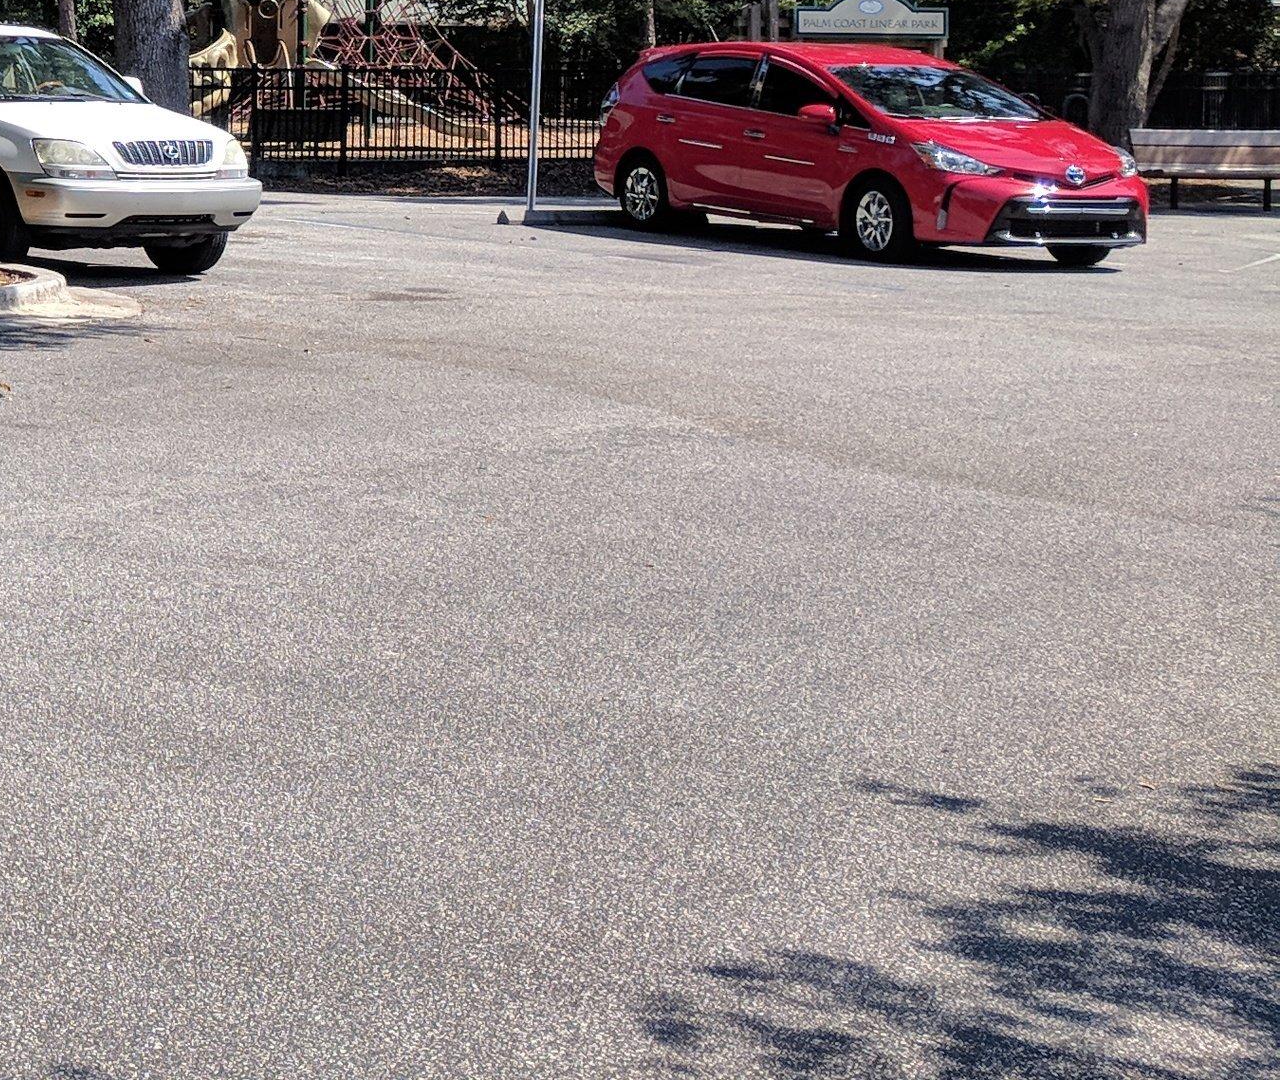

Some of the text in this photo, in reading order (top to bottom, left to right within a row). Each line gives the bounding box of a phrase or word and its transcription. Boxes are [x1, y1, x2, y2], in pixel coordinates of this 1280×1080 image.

[803, 18, 938, 29] PALM COAST LINEAR PARK
